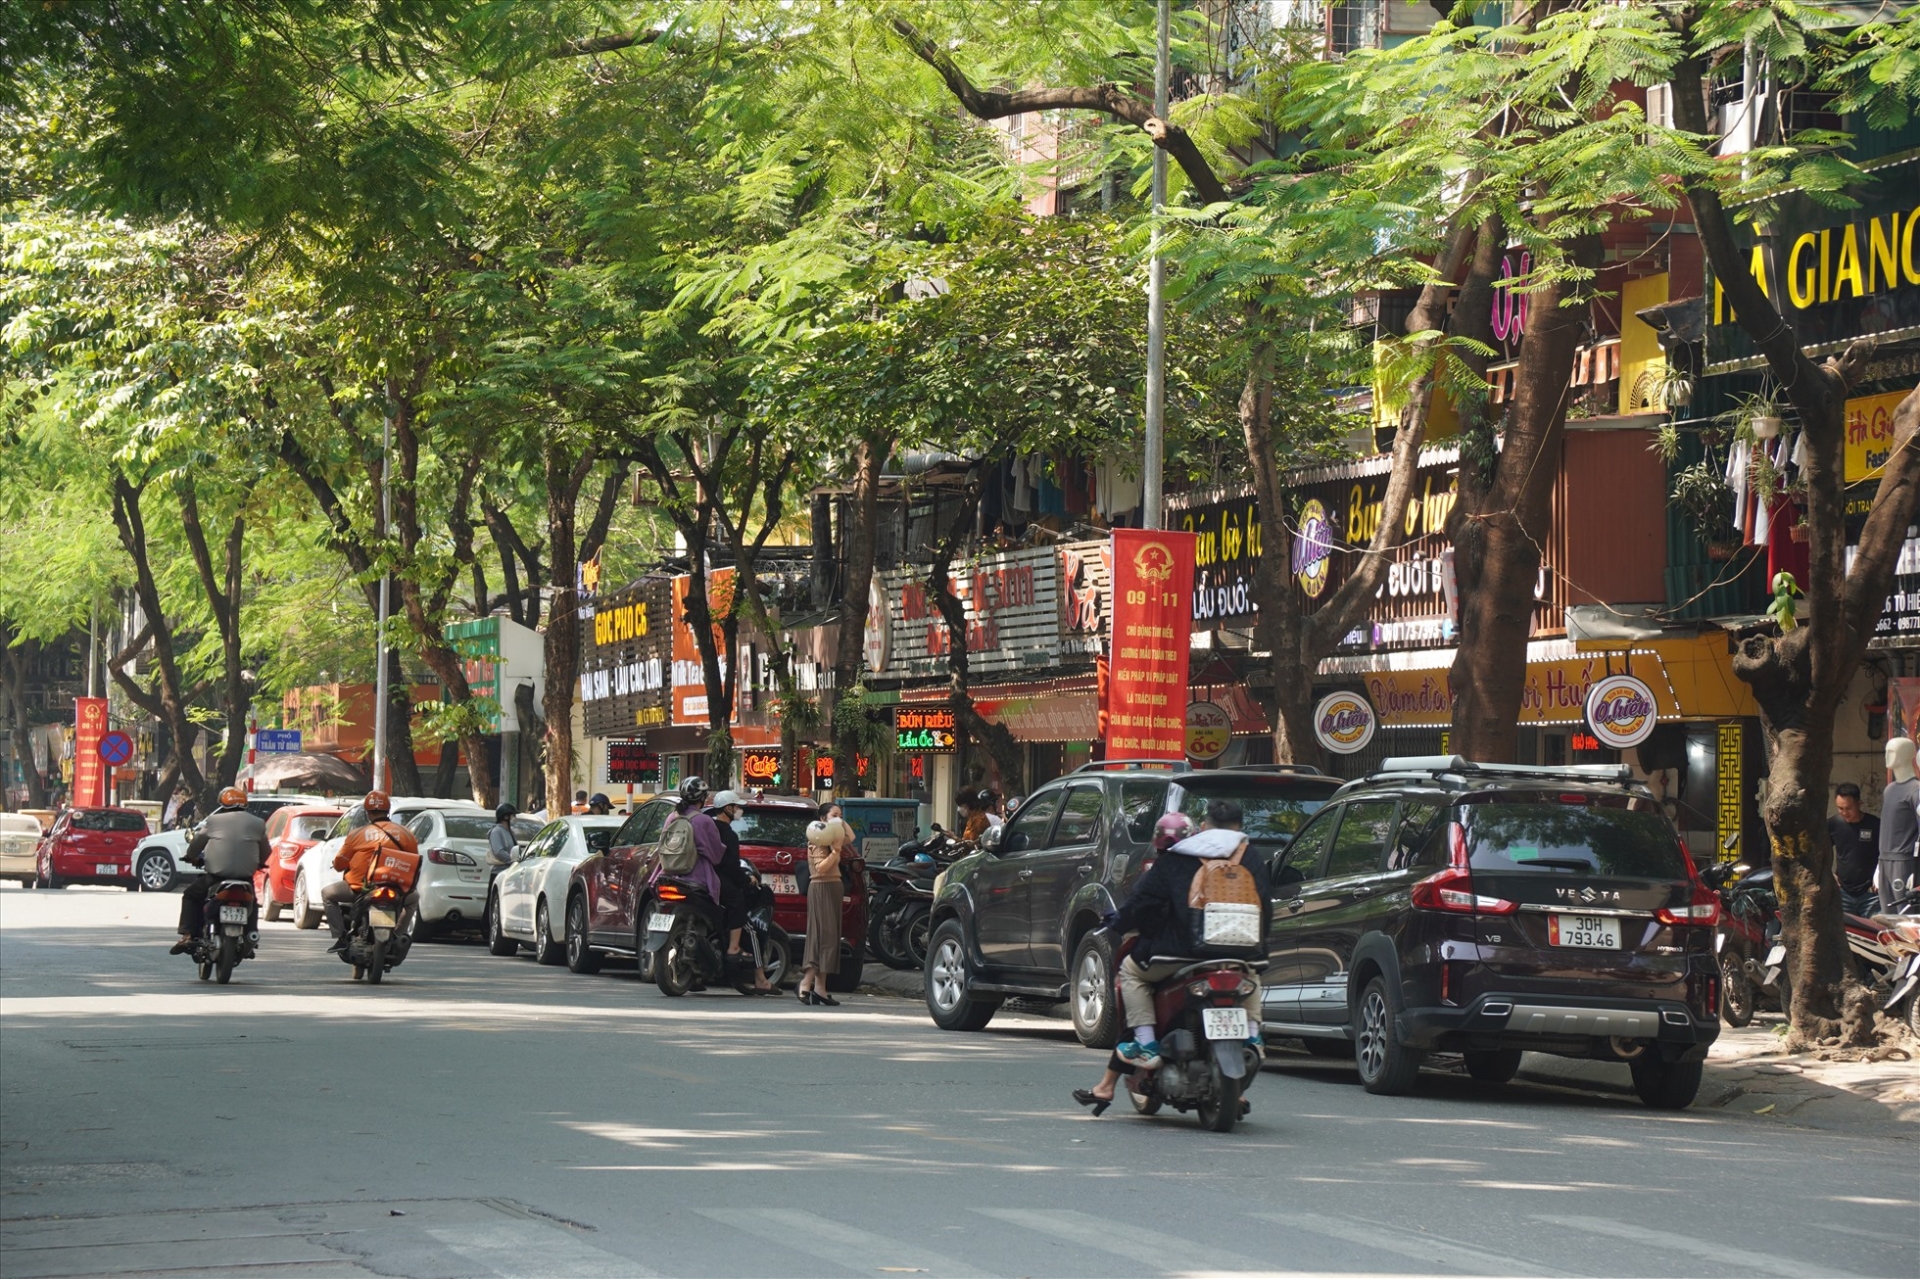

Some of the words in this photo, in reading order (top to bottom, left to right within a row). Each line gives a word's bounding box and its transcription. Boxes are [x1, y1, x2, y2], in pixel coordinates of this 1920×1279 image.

[1126, 590, 1146, 605] 09
[1162, 592, 1178, 607] 11
[900, 711, 923, 729] BÚN
[924, 711, 953, 729] RIÊU
[899, 730, 918, 747] Lẩu
[918, 729, 933, 747] Ốc
[772, 875, 789, 884] 30G
[768, 884, 796, 893] 71.92
[1576, 917, 1602, 931] 30H
[1566, 931, 1614, 947] 793.46
